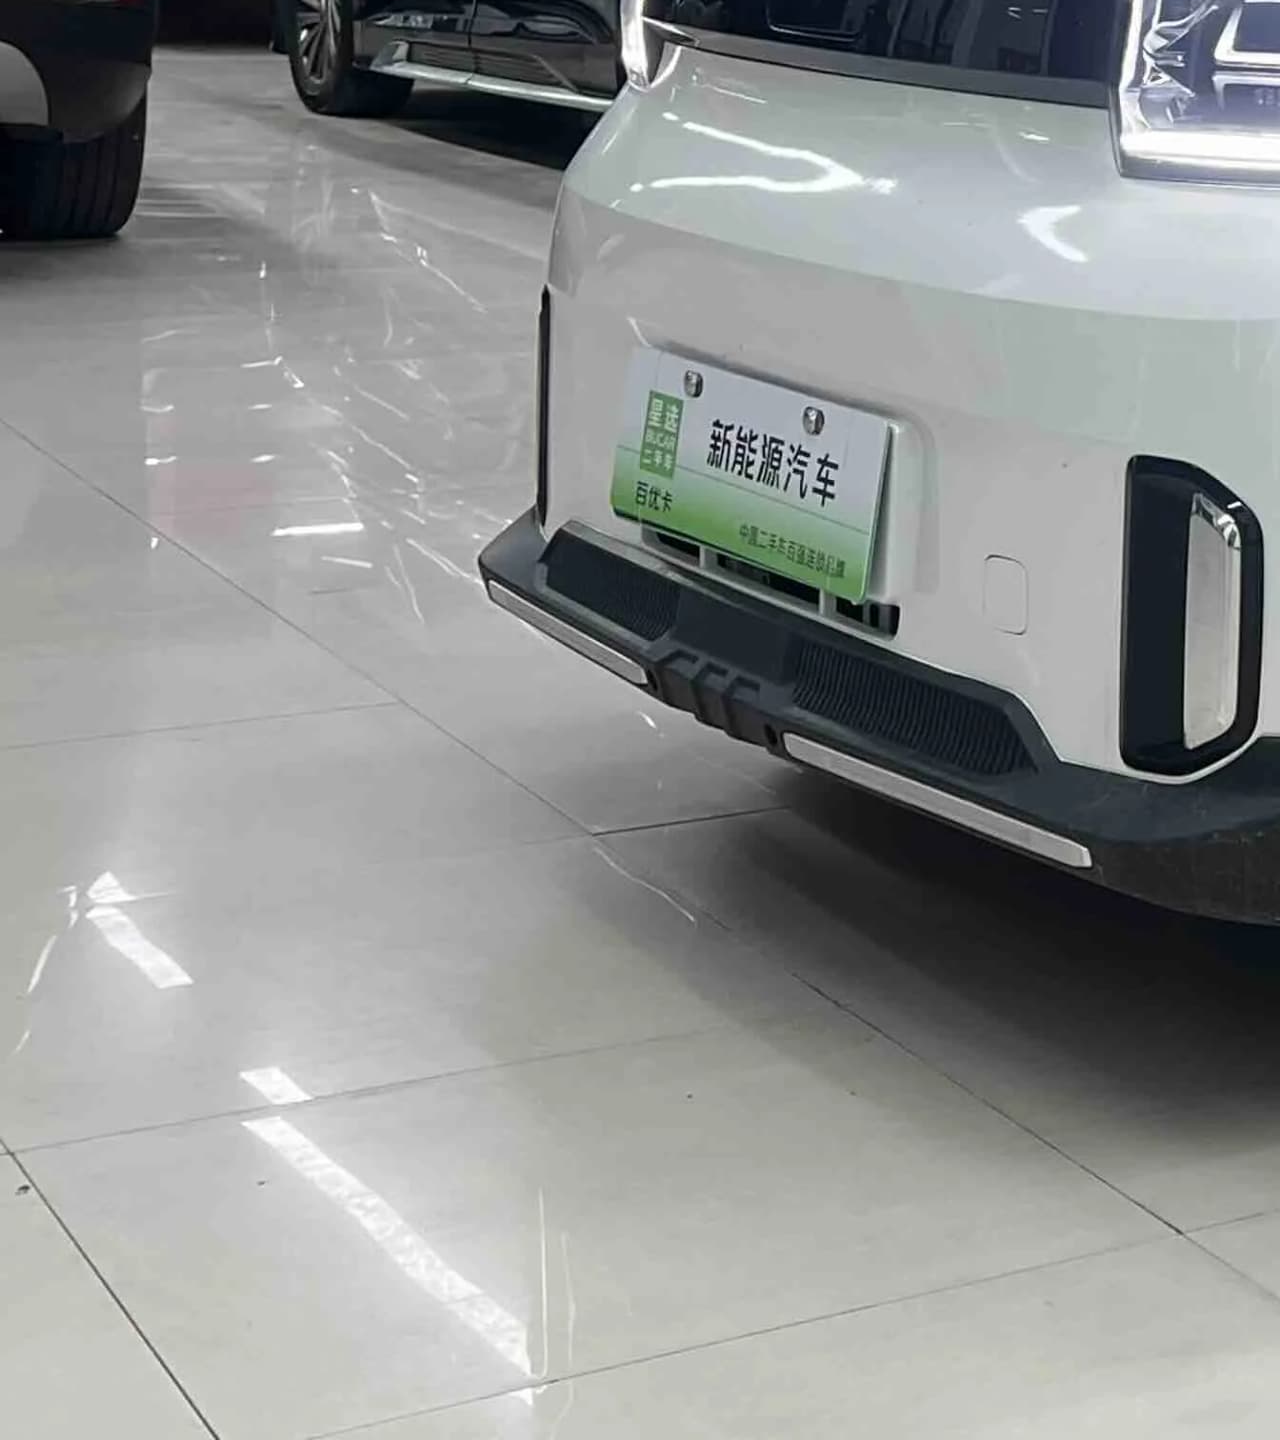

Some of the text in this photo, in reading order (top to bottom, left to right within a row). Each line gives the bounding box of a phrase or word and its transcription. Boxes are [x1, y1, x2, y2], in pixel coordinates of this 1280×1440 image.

[706, 418, 840, 508] 新能源汽车
